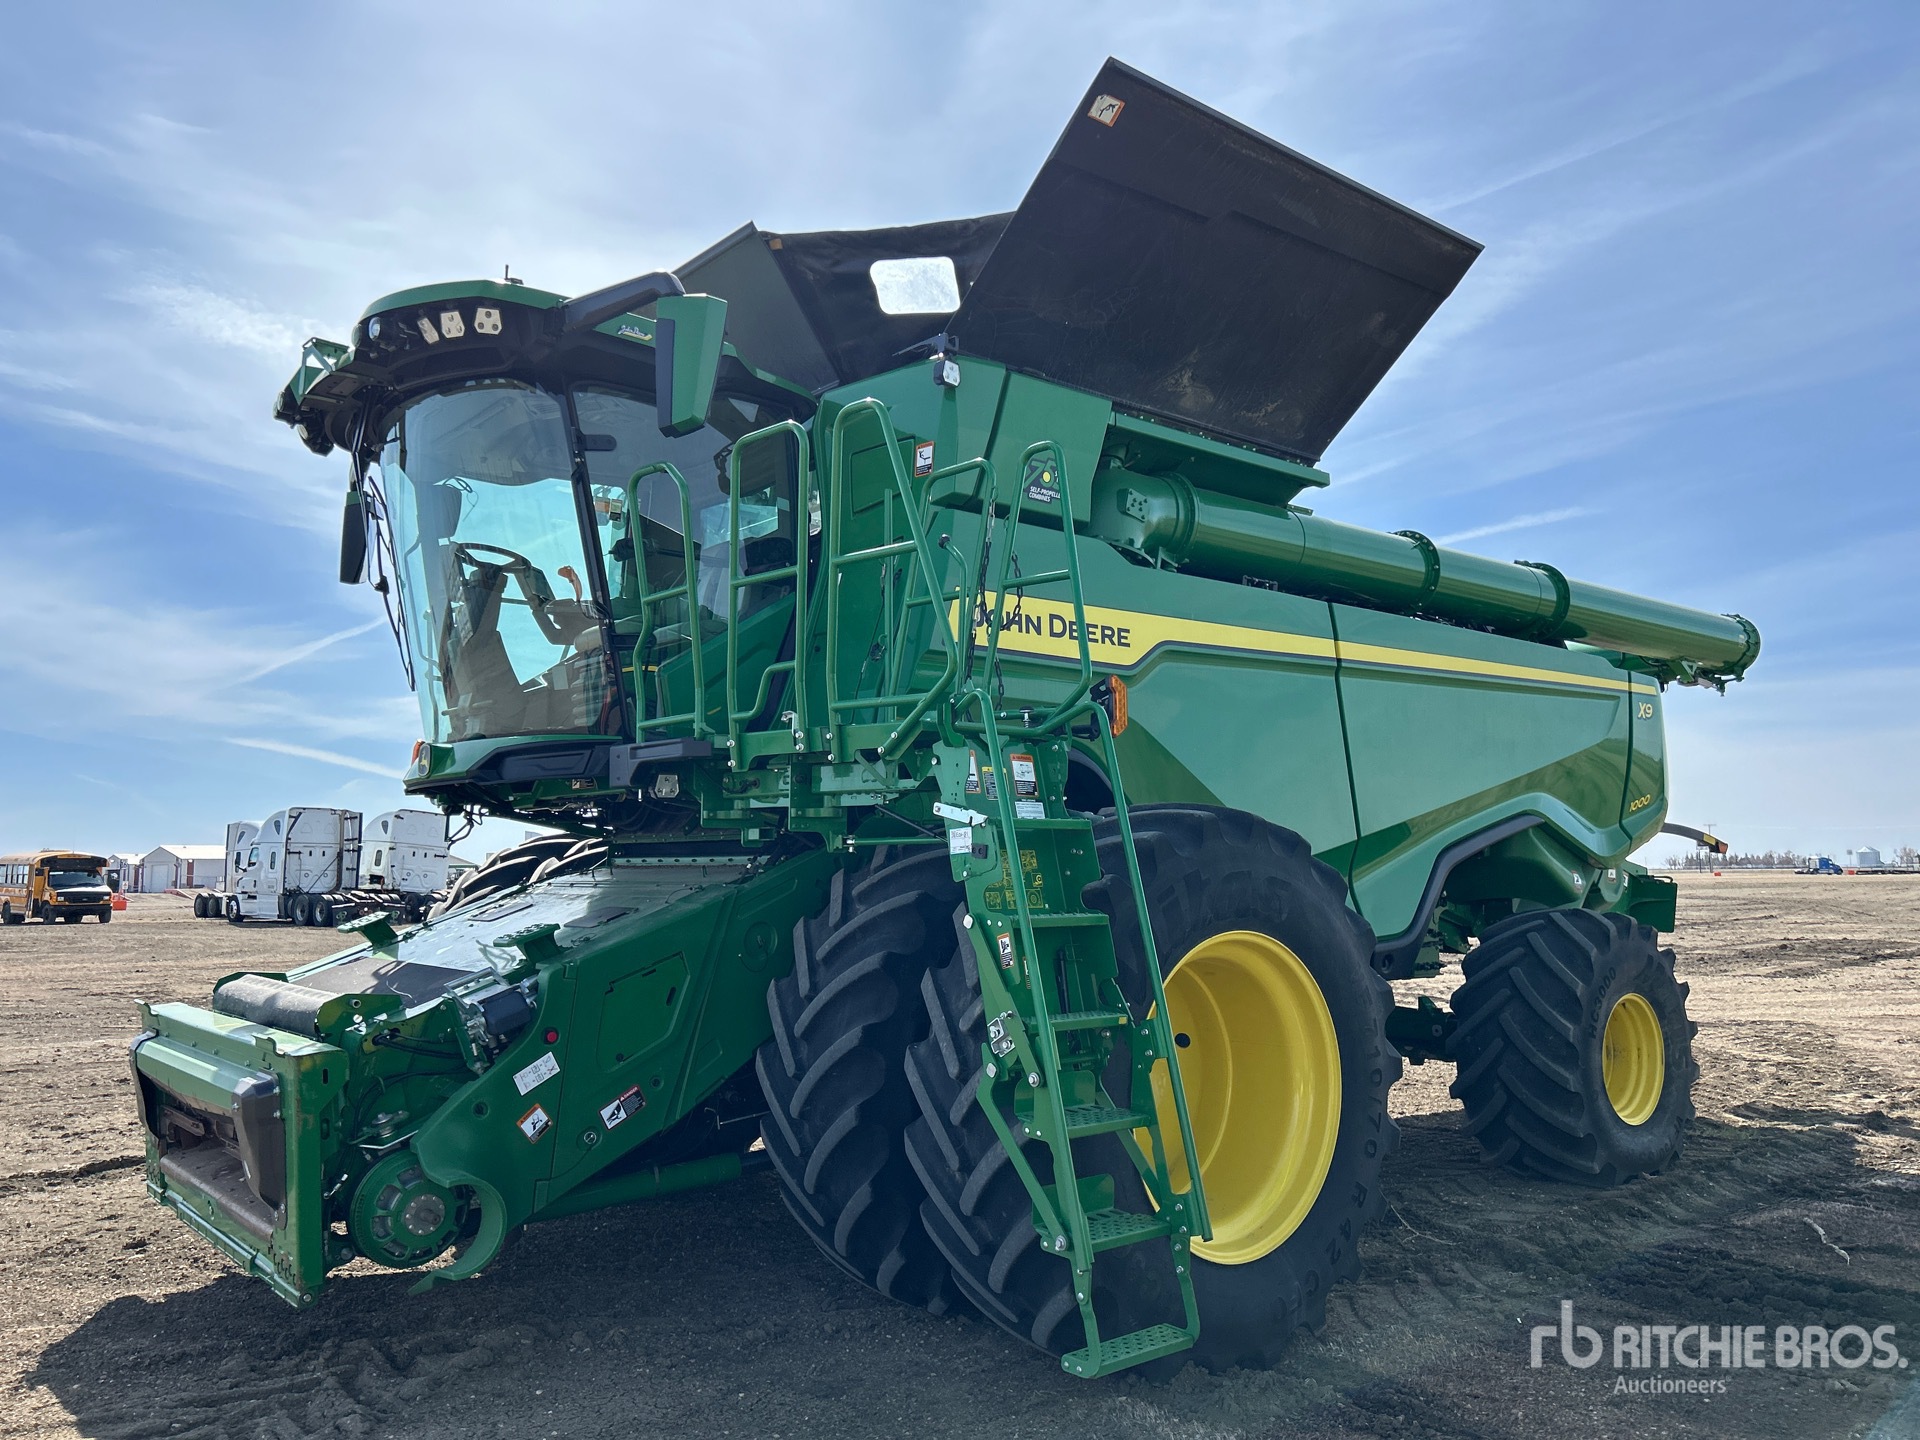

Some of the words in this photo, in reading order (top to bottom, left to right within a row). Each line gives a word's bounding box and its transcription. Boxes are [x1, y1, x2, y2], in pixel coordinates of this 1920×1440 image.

[1049, 613, 1131, 648] DEERE
[1637, 701, 1653, 720] X9
[1629, 793, 1651, 813] 1000
